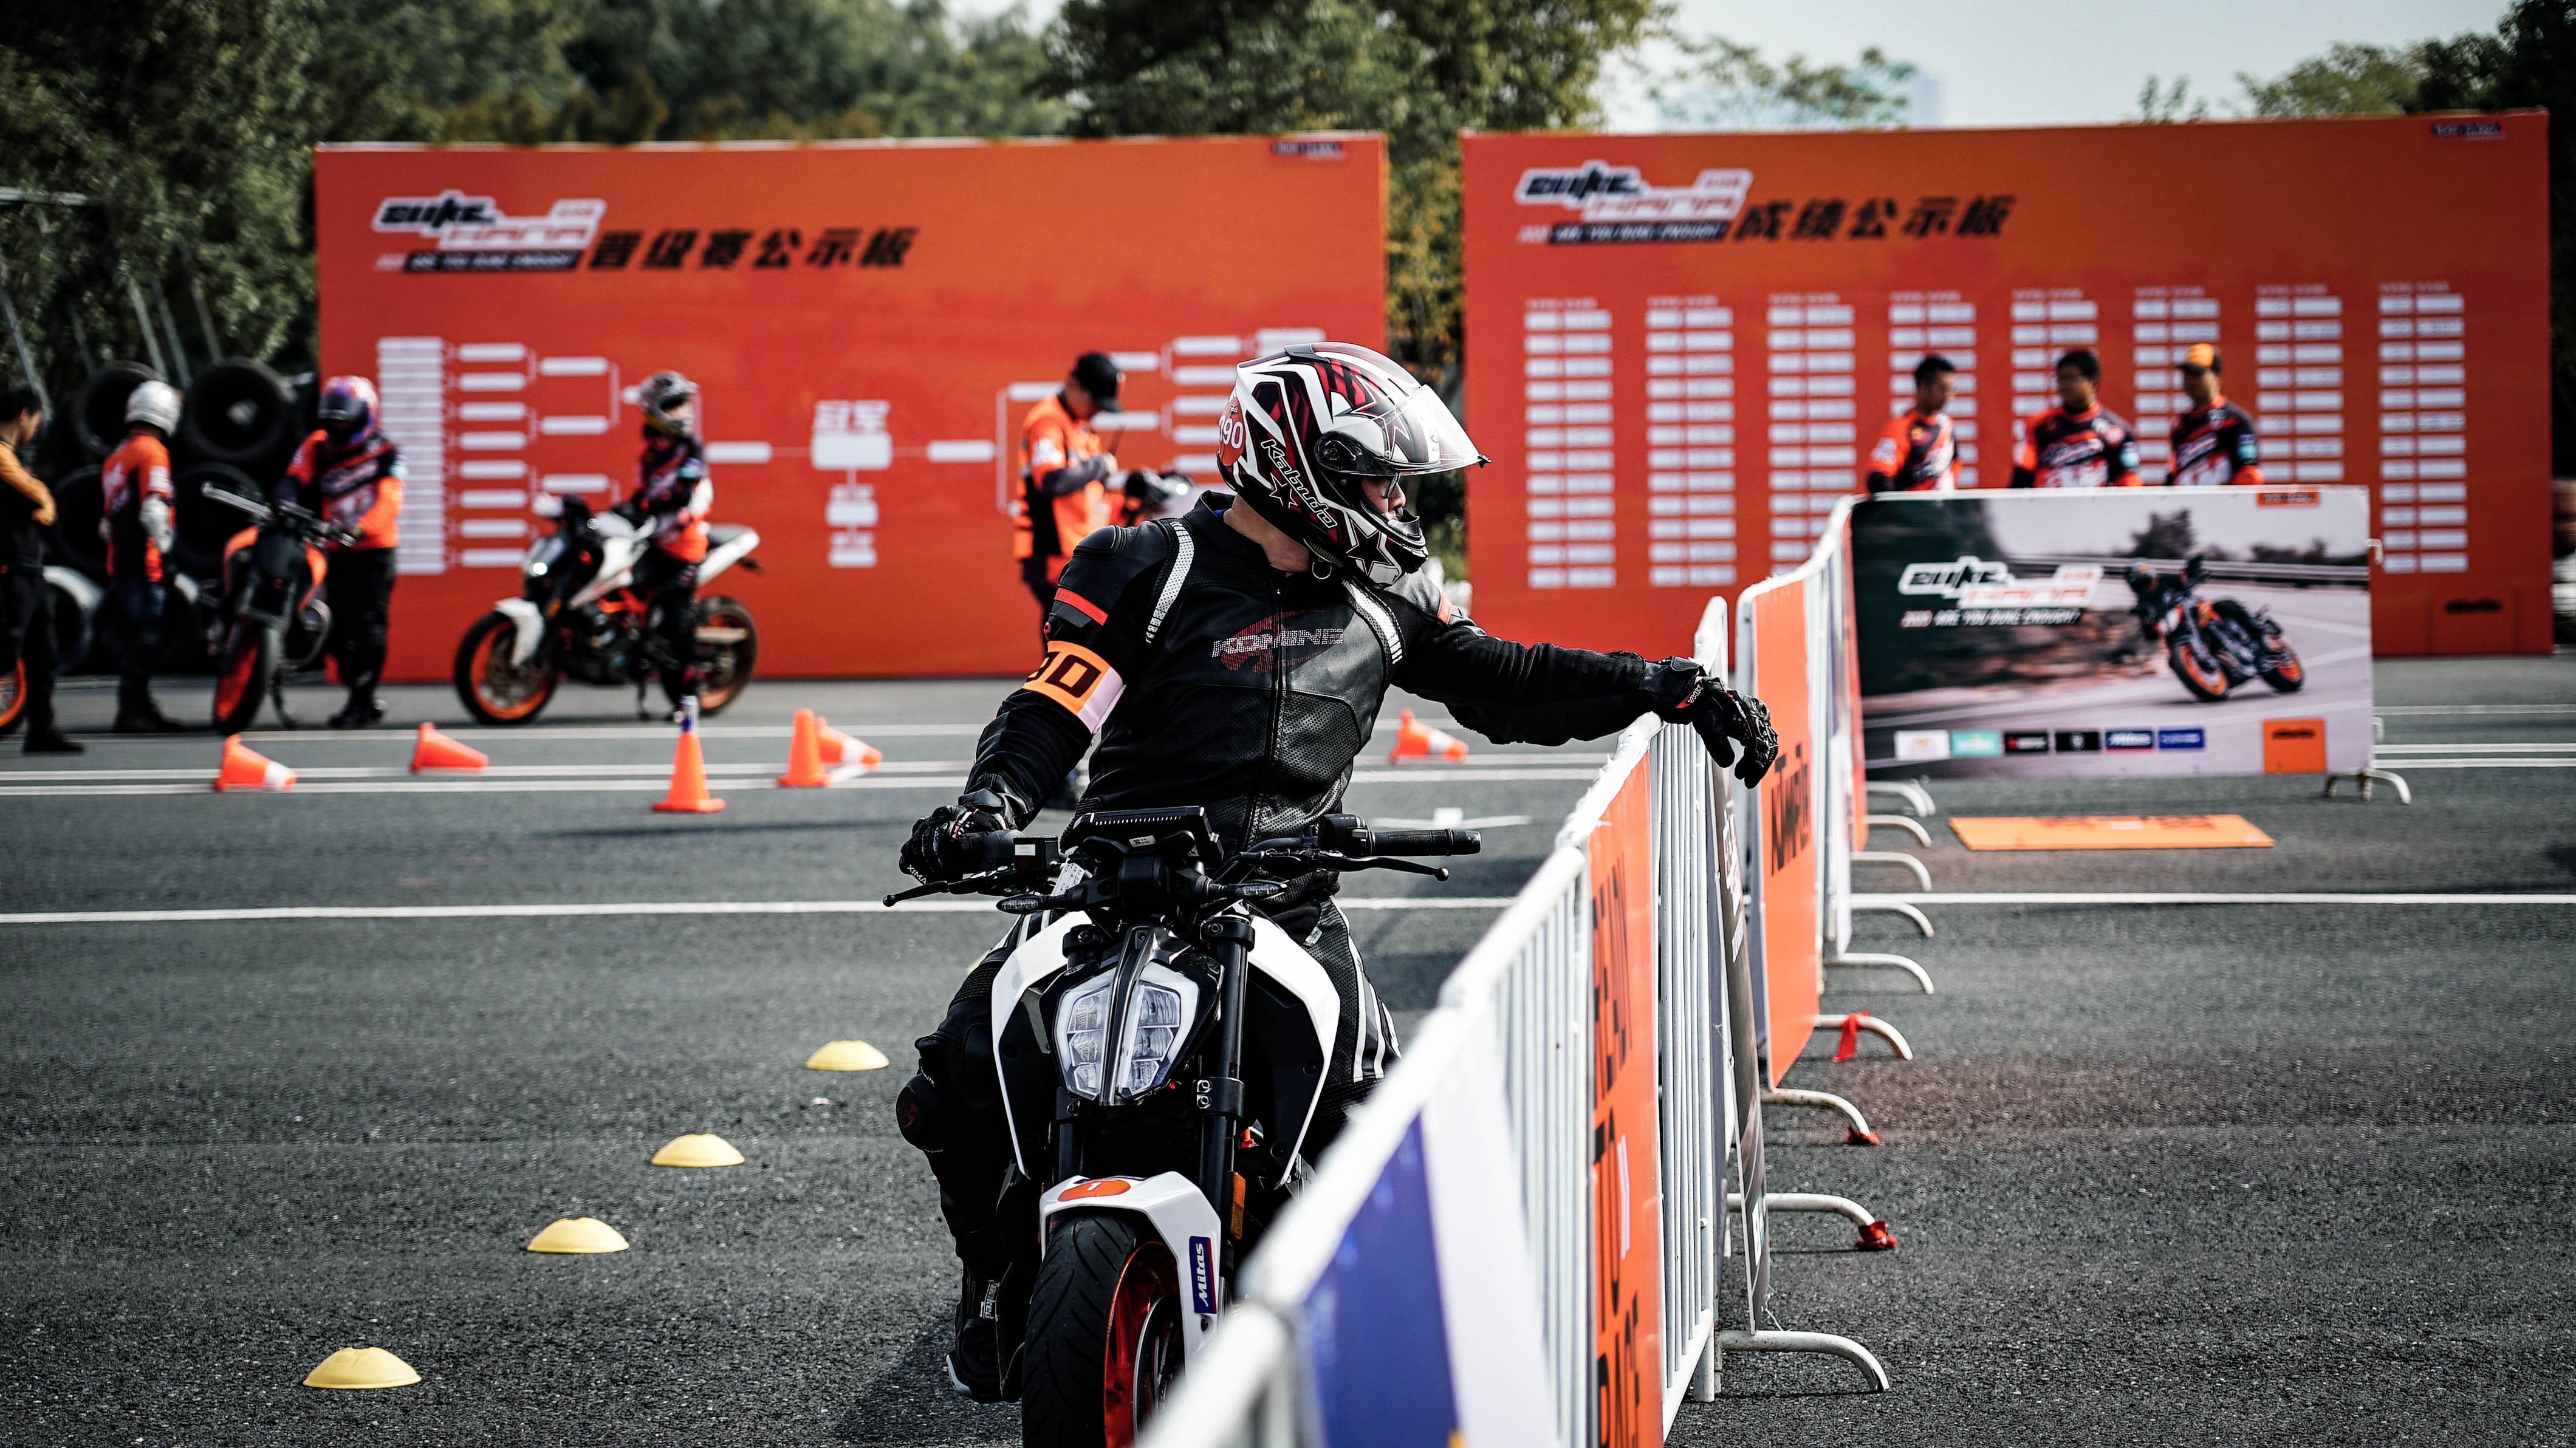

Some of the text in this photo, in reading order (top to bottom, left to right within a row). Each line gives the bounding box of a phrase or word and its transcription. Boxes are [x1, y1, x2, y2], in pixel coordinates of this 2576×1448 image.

[1261, 439, 1338, 528] Kabuto
[1212, 628, 1345, 658] KOMINE
[1196, 1243, 1209, 1307] Mitas
